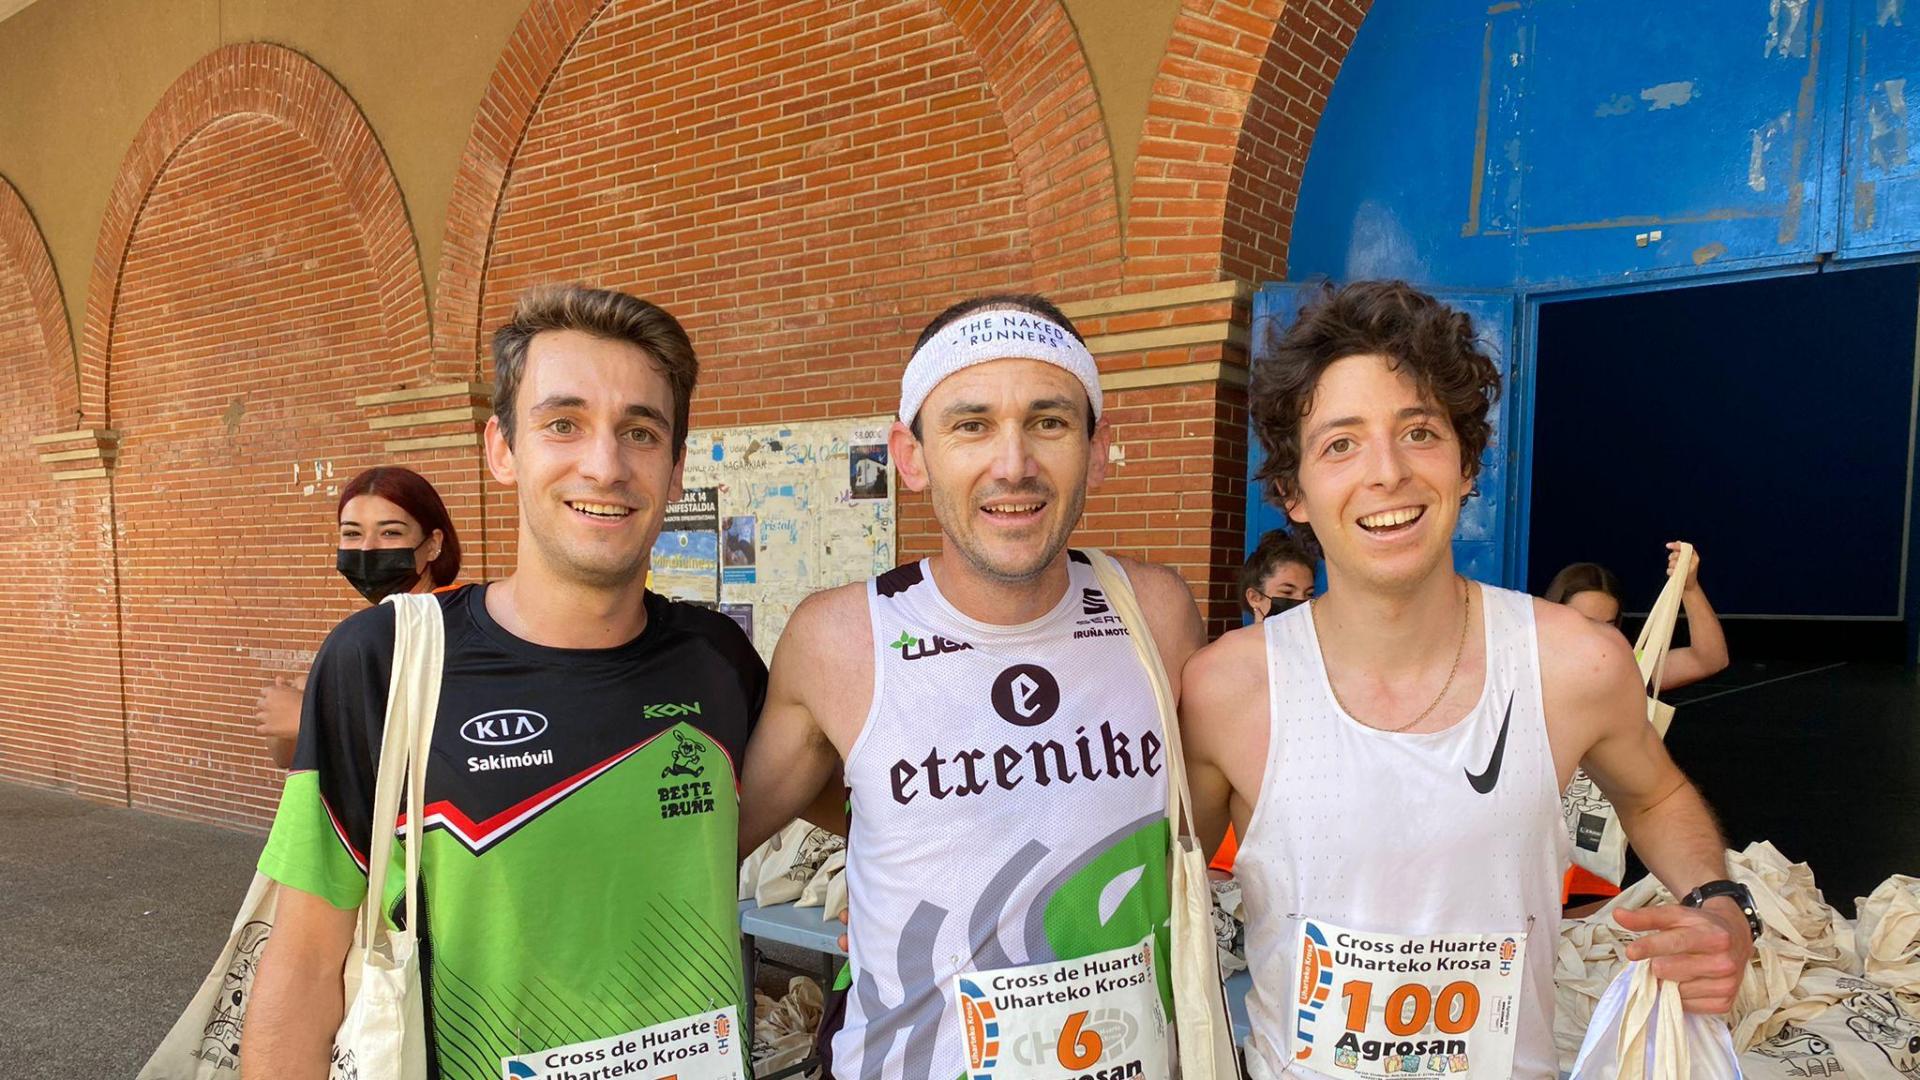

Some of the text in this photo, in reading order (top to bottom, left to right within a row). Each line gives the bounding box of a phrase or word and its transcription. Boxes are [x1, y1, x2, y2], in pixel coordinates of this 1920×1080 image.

[960, 316, 1063, 340] THE NAKED
[971, 329, 1057, 348] RUNNERS
[665, 502, 716, 513] ANIFESTALDIA
[698, 491, 707, 502] 14
[1074, 628, 1103, 639] IRUÑA
[475, 717, 535, 739] KIA
[467, 749, 553, 773] Sakimóvil
[890, 720, 1162, 805] etxenike
[658, 782, 713, 802] BESTE
[1337, 933, 1497, 954] Cross de Huarte
[992, 973, 1048, 991] Cross
[1054, 967, 1079, 983] de
[1084, 952, 1144, 977] Huarte
[1335, 951, 1491, 973] Uharteko Krosa
[994, 986, 1091, 1011] Uharteko
[1096, 972, 1145, 994] Krosa
[1342, 979, 1481, 1036] 100
[545, 1020, 711, 1070] Cross de Huarte
[1056, 1010, 1103, 1071] 6
[1335, 1032, 1466, 1061] Agrosan
[654, 1041, 709, 1066] Krosa
